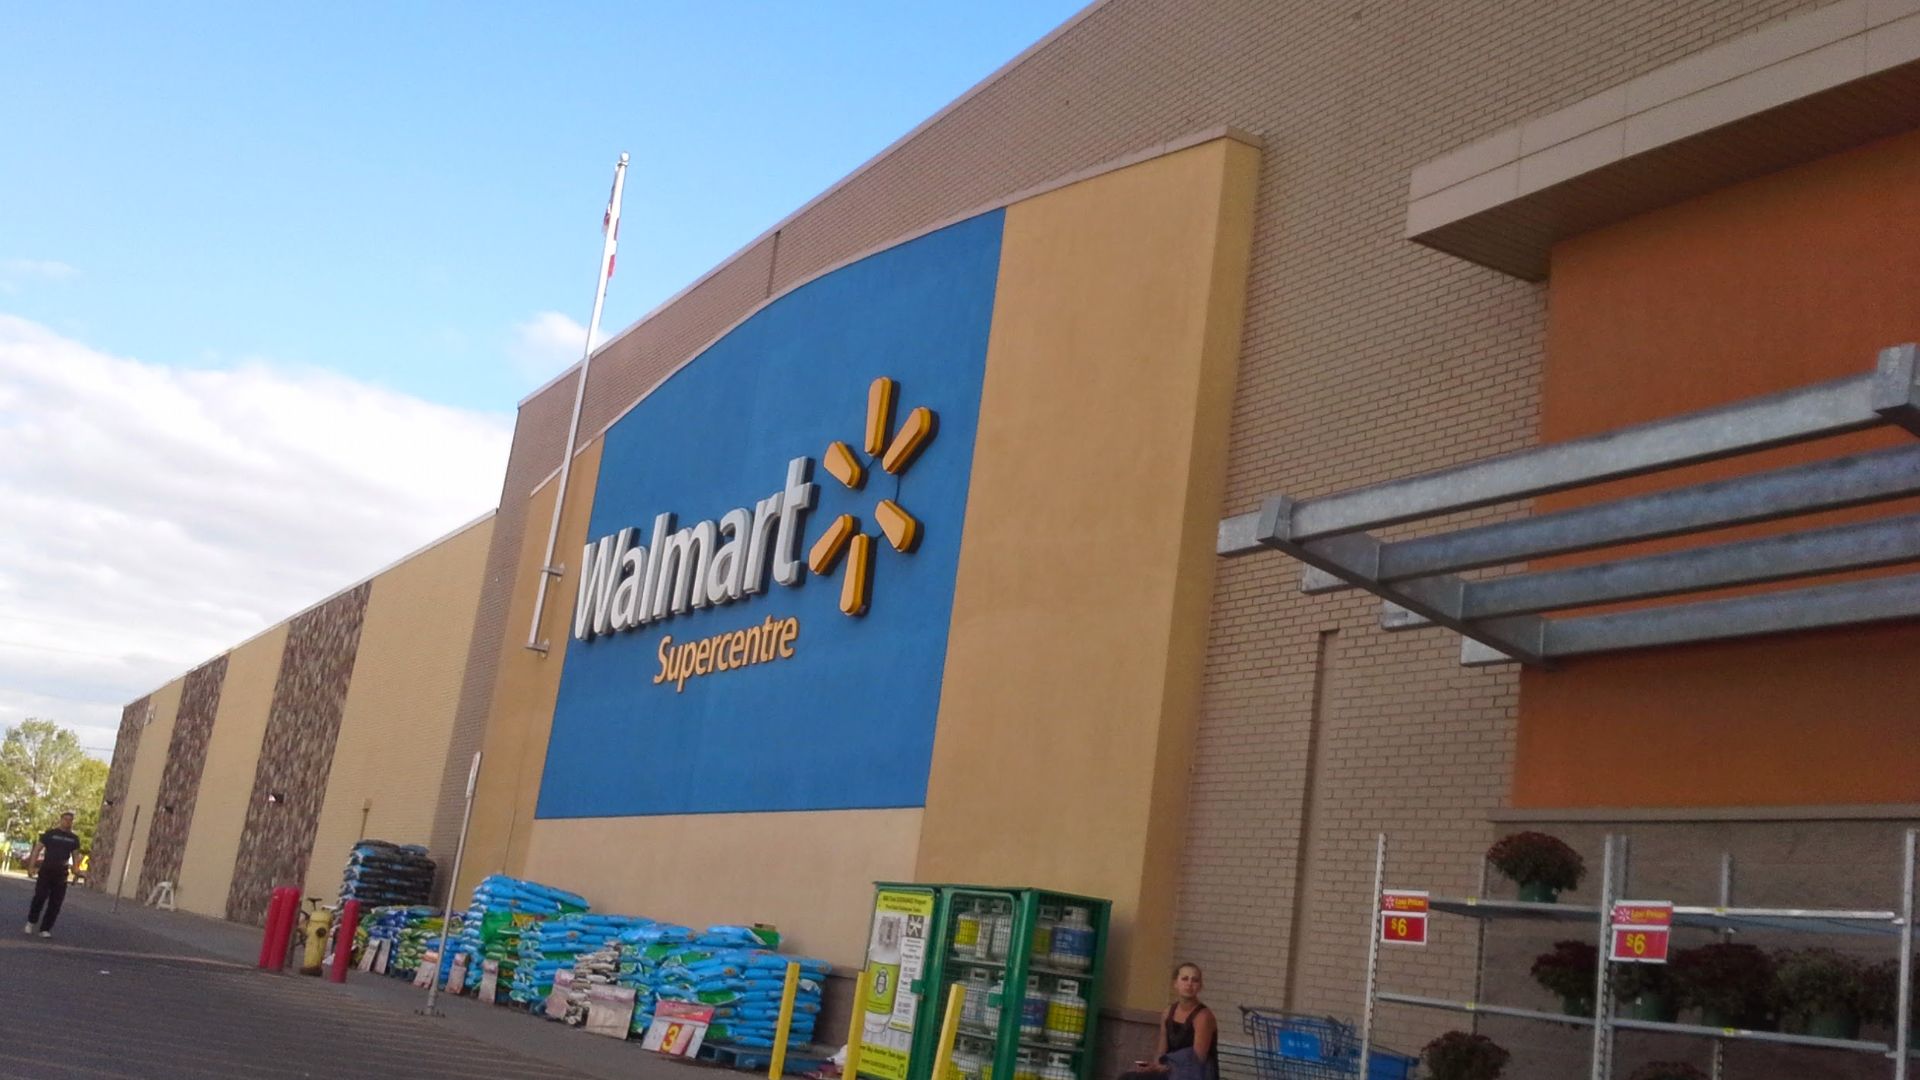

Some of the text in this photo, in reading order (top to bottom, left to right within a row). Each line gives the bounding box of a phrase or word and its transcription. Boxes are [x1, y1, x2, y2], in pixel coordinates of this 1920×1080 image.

[575, 456, 813, 641] Walmart
[653, 614, 799, 693] Supercentre
[1391, 917, 1408, 937] $6
[1626, 933, 1646, 955] $6
[661, 1024, 680, 1052] 3
